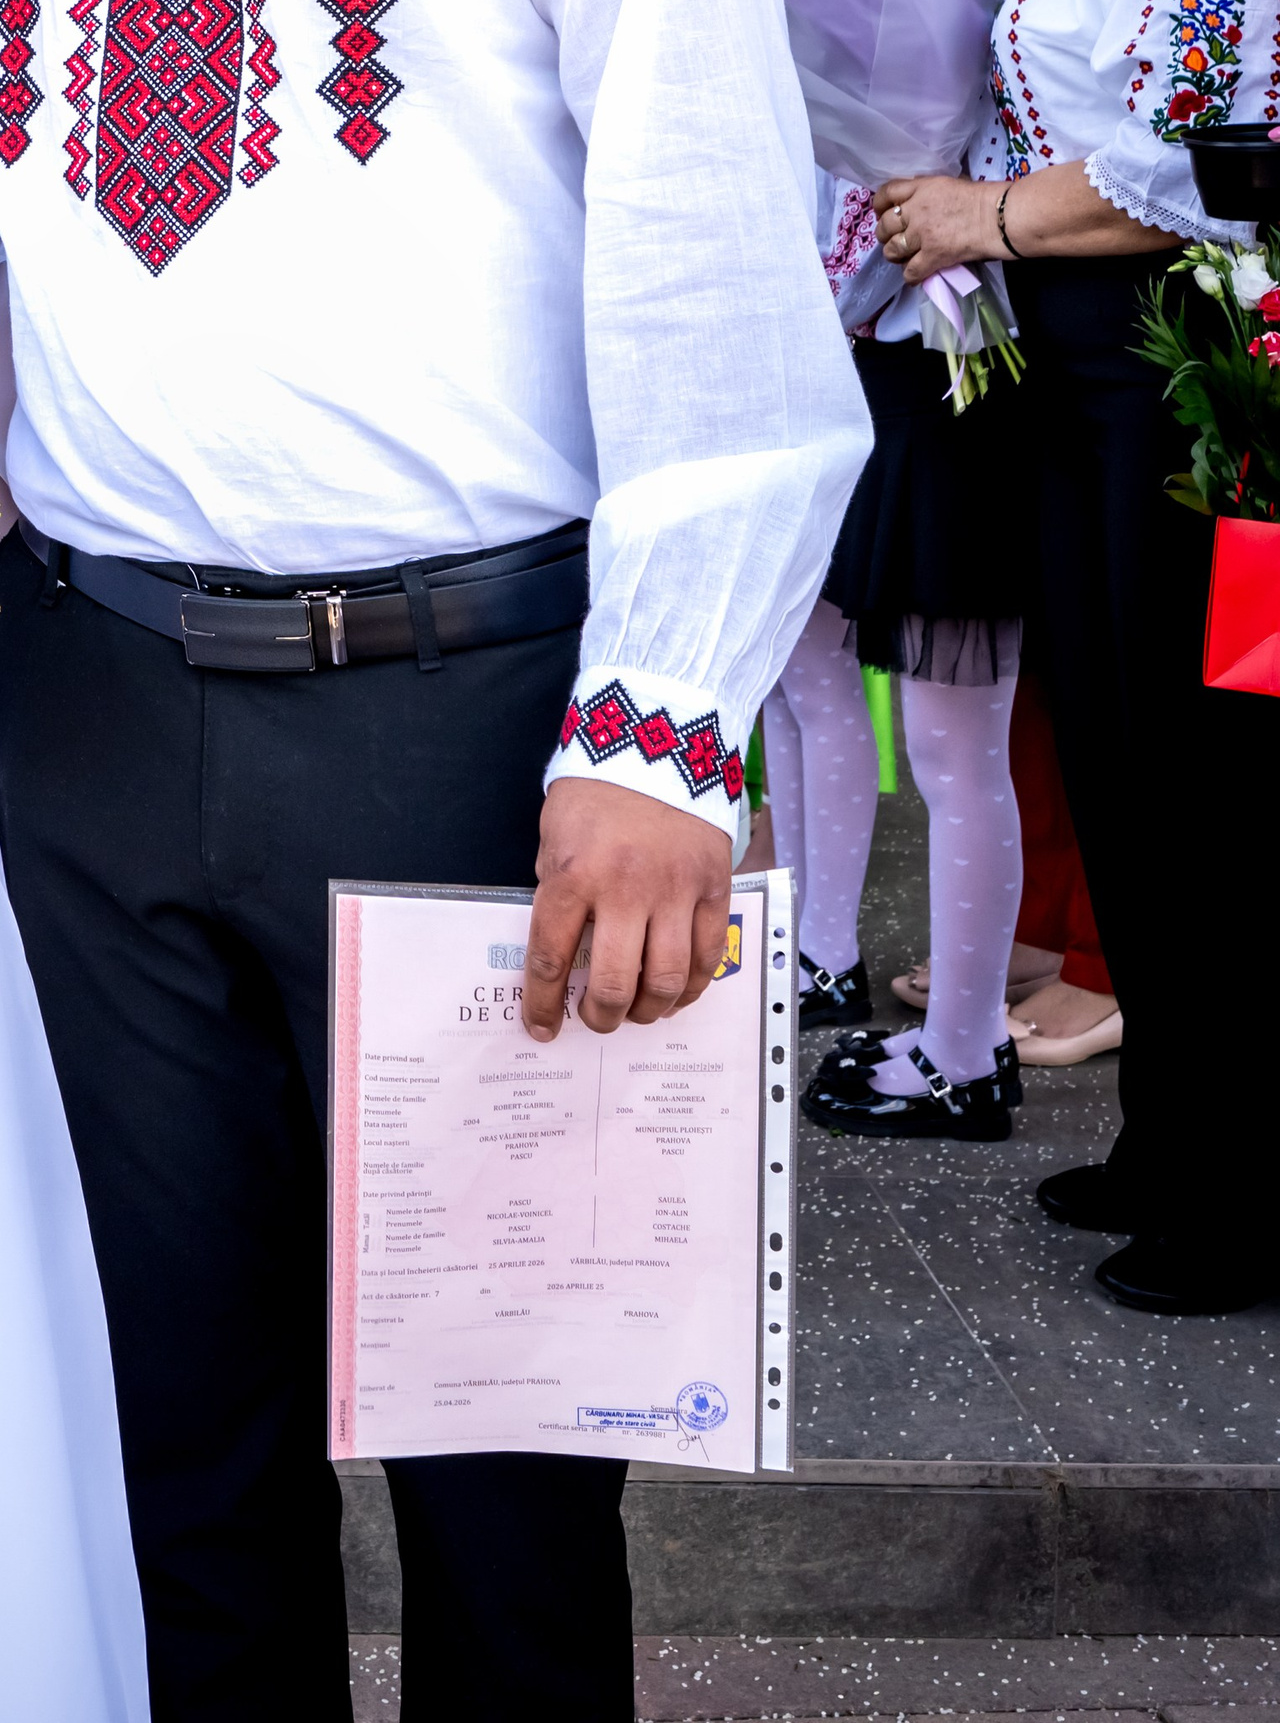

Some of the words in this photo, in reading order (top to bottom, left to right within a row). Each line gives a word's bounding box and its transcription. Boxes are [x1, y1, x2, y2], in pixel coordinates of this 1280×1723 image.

[459, 1007, 489, 1022] DE
[365, 1053, 380, 1062] Date
[382, 1055, 405, 1063] privind
[410, 1077, 440, 1085] personal
[493, 1102, 555, 1112] ROBERT-GABRIEL
[381, 1122, 407, 1130] nașterii
[680, 1127, 712, 1135] PLOIEȘTI
[479, 1135, 498, 1143] ORAȘ
[384, 1140, 410, 1148] nașterii
[505, 1142, 539, 1150] PRAHOVA
[380, 1191, 405, 1199] privind
[423, 1206, 446, 1214] familie
[422, 1231, 445, 1239] familie
[493, 1237, 545, 1246] SILVIA-AMALIA
[654, 1236, 688, 1244] MIHAELA
[498, 1261, 526, 1269] APRILIE
[636, 1258, 670, 1268] PRAHOVA
[388, 1268, 405, 1276] locul
[443, 1264, 478, 1273] căsătoriei
[547, 1282, 564, 1290] 2026
[566, 1282, 594, 1290] APRILIE
[596, 1282, 604, 1290] 25
[495, 1309, 530, 1317] VĂRBILĂU
[624, 1310, 660, 1319] PRAHOVA
[462, 1378, 500, 1387] VĂRBILĂU,
[501, 1378, 524, 1387] județul
[526, 1378, 561, 1386] PRAHOVA
[359, 1384, 385, 1392] Eliberat
[434, 1399, 471, 1407] 25.04.2026
[538, 1422, 569, 1431] Certificat
